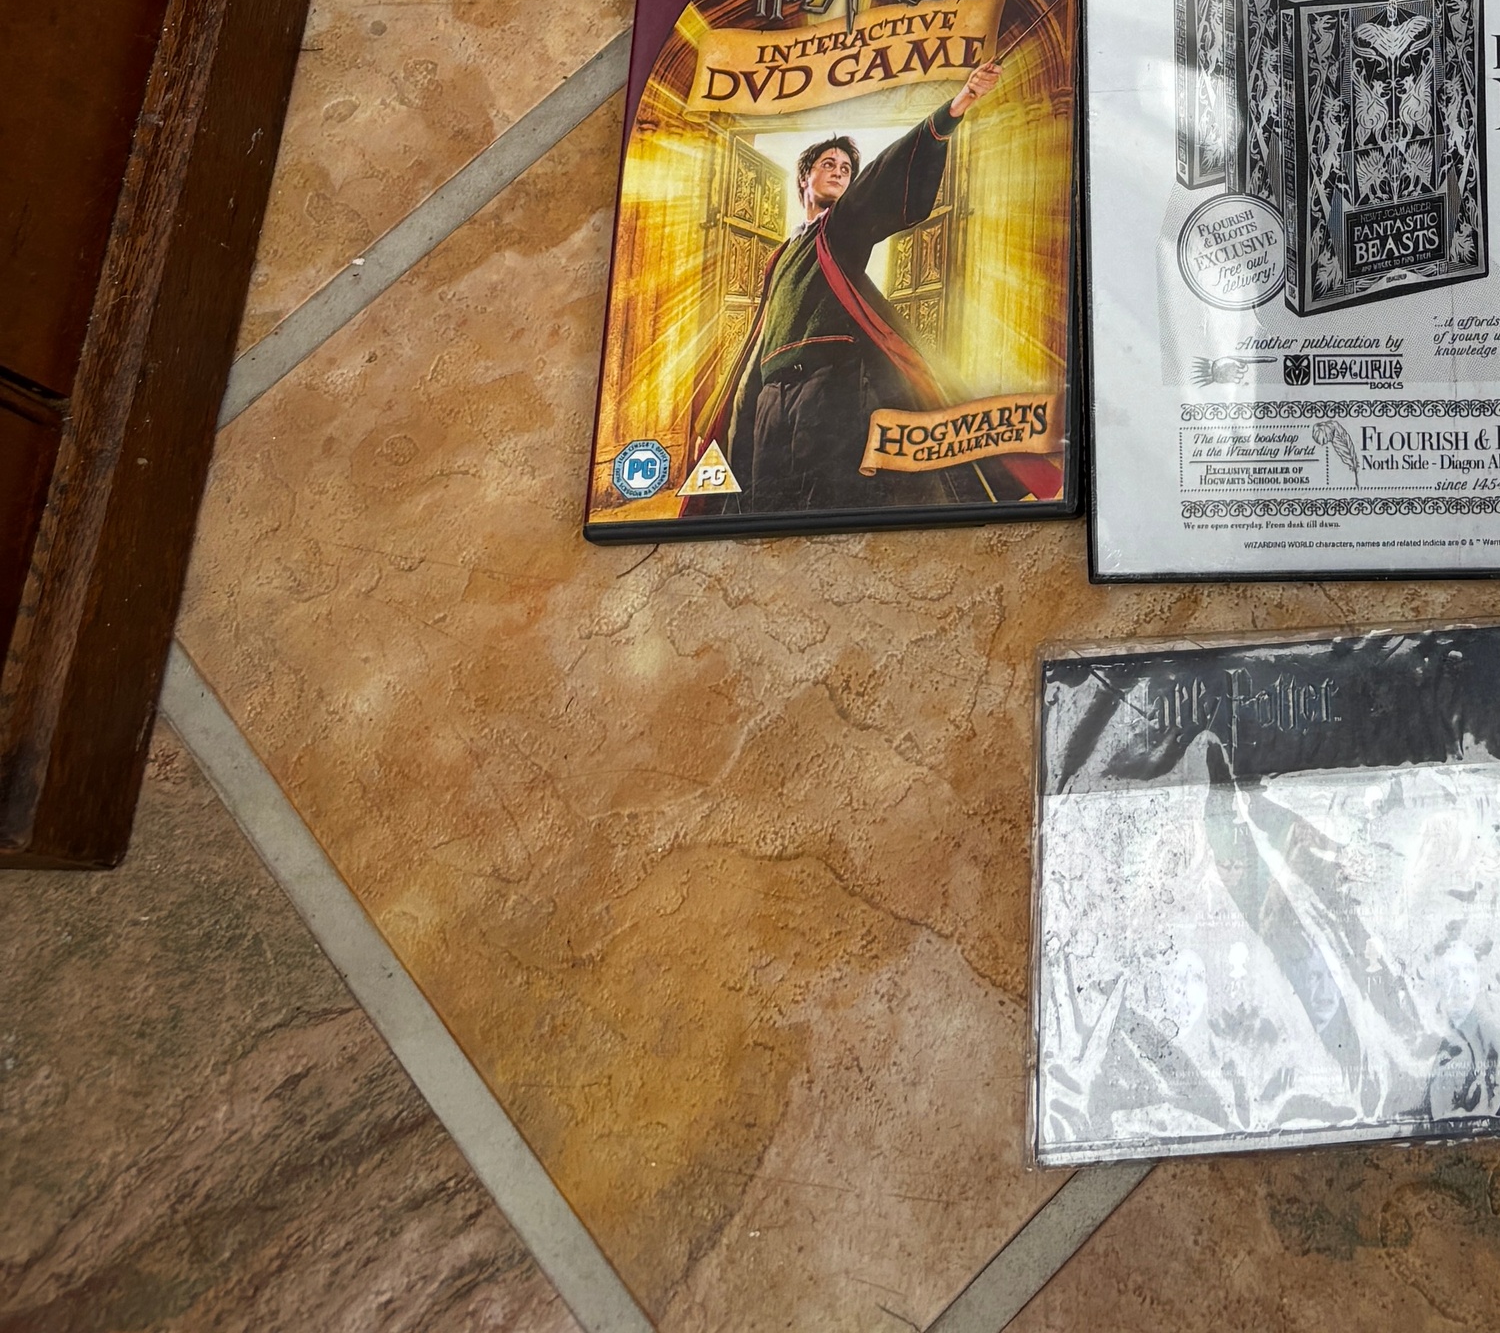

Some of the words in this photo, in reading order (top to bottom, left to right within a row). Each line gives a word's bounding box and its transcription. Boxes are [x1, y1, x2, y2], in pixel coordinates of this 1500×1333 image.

[756, 10, 958, 65] INTERACTIVE
[702, 65, 813, 103] DVD
[827, 35, 987, 87] GAME
[1236, 336, 1298, 350] Another
[1299, 335, 1380, 352] publication
[1386, 335, 1403, 352] by
[874, 402, 1047, 457] HOGWARTS
[1361, 426, 1469, 451] FLOURISH
[1474, 428, 1491, 450] &
[913, 427, 1024, 461] CHALLENGE
[628, 458, 657, 480] PG
[1362, 454, 1399, 470] North
[1402, 454, 1429, 470] Side
[1440, 454, 1485, 474] Diagon
[698, 465, 726, 488] PG
[1435, 479, 1468, 490] since
